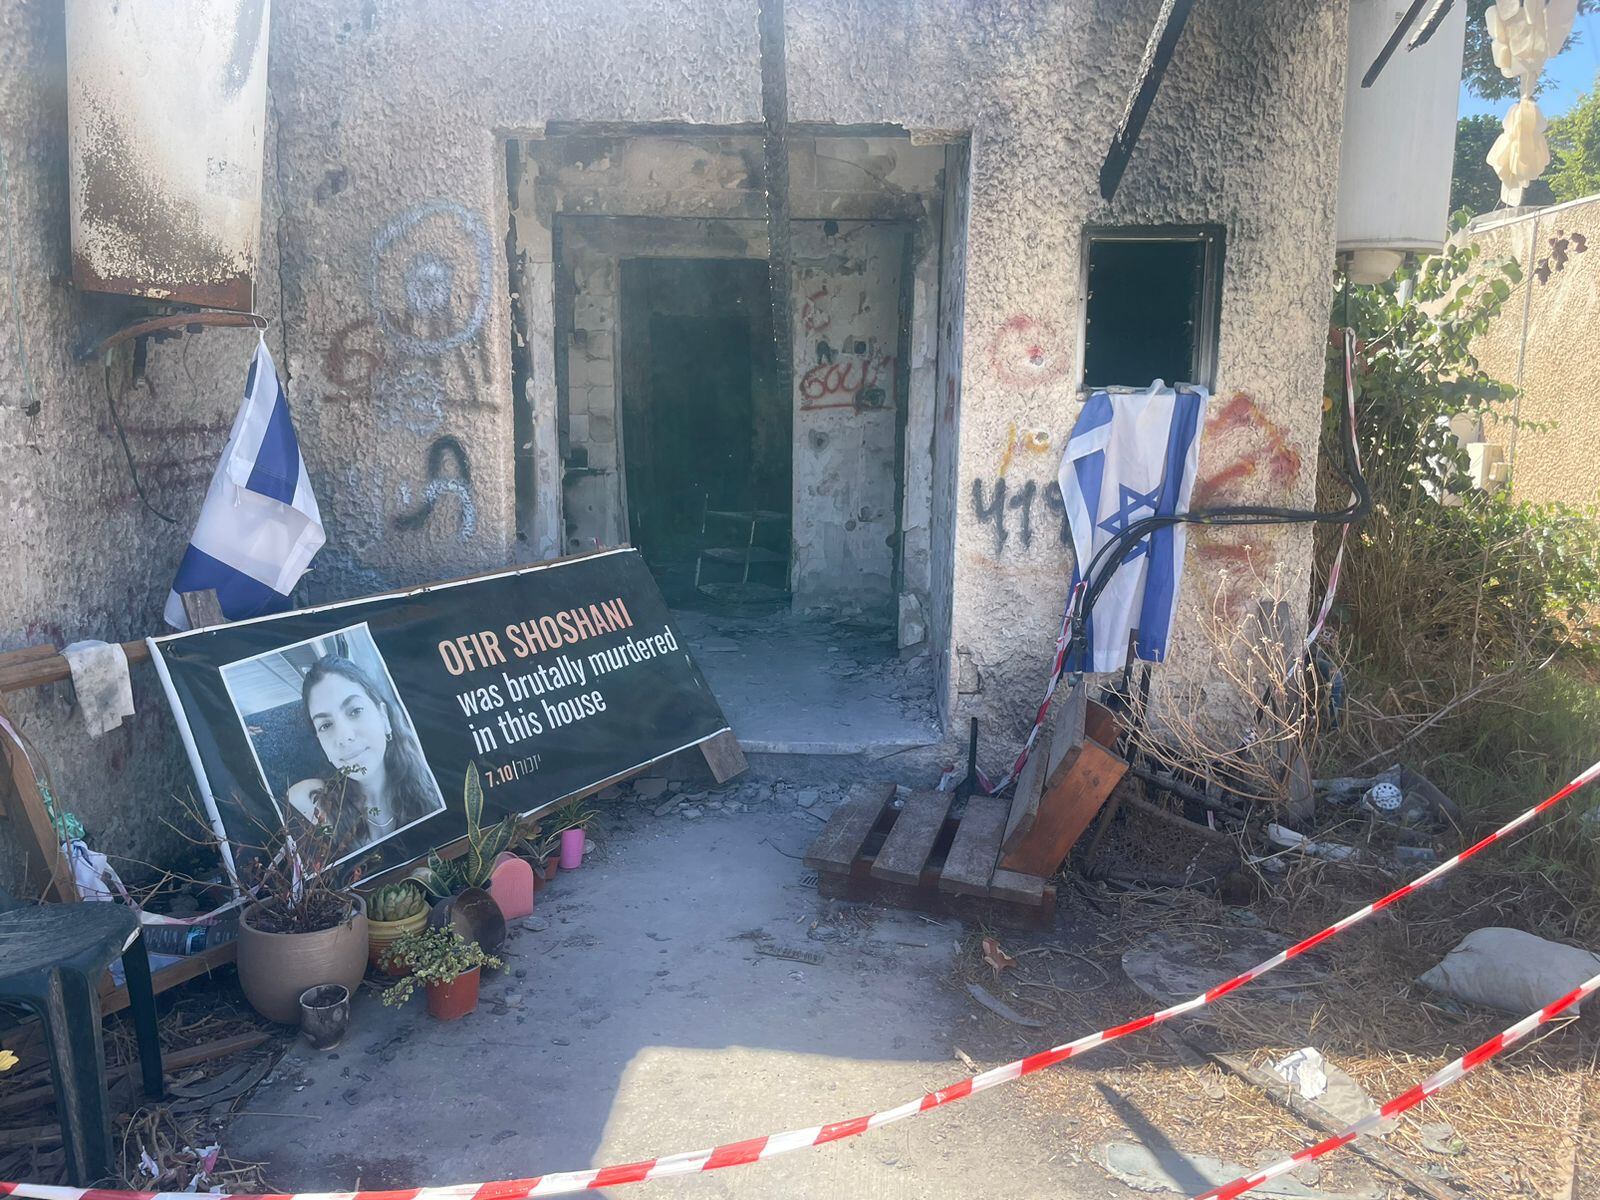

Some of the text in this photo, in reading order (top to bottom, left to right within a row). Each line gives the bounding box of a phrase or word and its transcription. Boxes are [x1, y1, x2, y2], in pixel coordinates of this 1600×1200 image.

[437, 597, 634, 676] OFIR SHOSHANI
[456, 624, 680, 718] was brutally murdered
[468, 690, 607, 755] in this house
